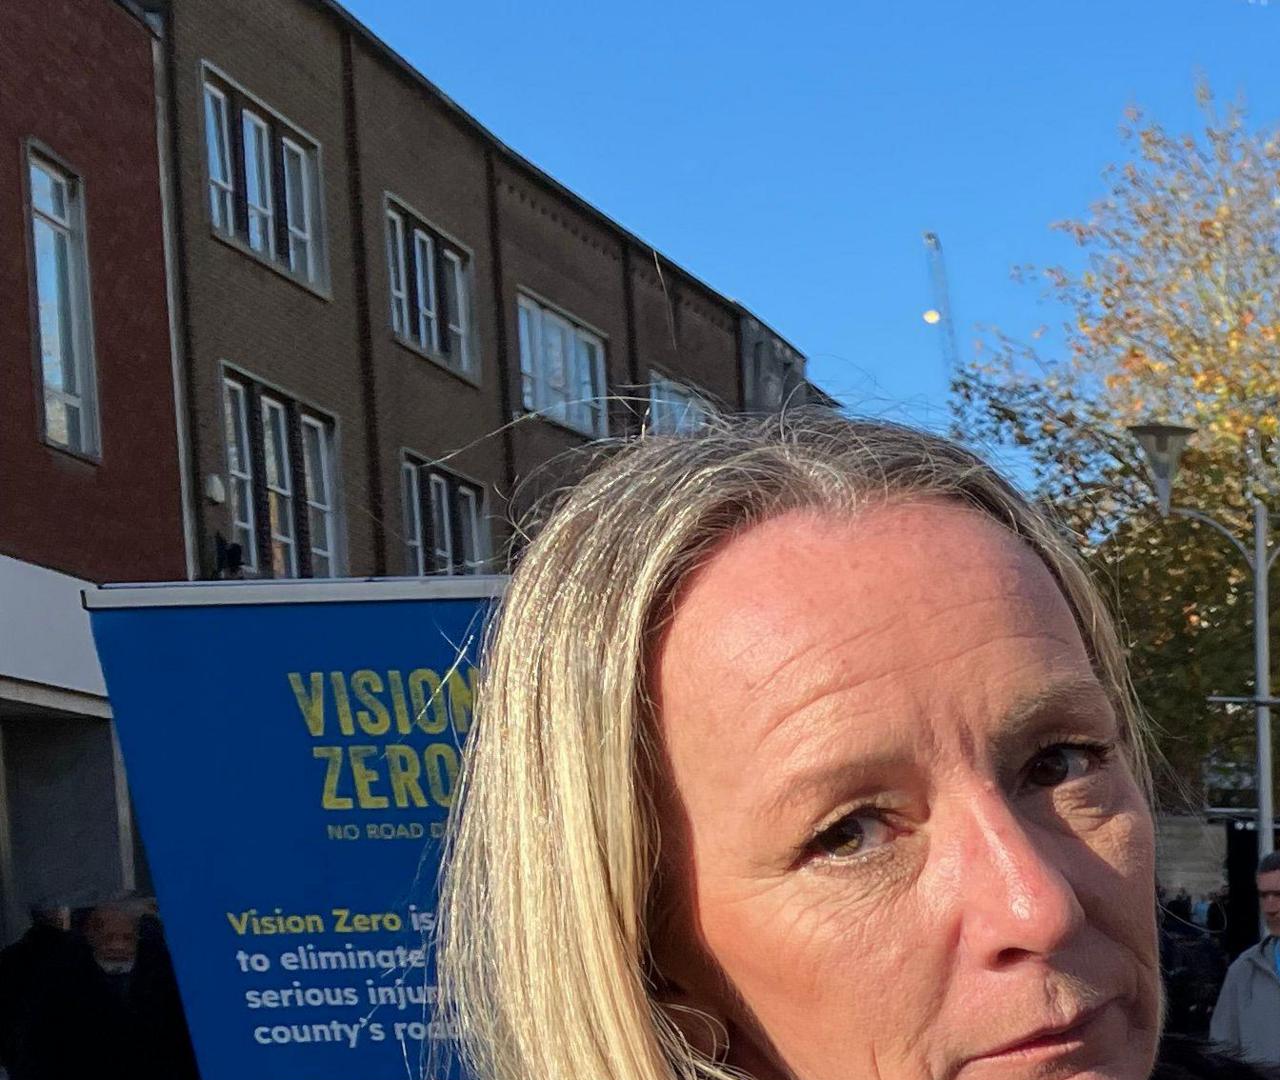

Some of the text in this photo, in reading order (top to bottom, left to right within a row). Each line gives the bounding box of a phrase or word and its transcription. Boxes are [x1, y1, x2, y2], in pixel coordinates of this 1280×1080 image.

[288, 668, 479, 736] VISION
[313, 743, 459, 810] ZERO
[327, 824, 360, 840] NO
[366, 823, 424, 840] ROAD
[227, 904, 436, 935] Vision Zero is
[236, 943, 427, 972] to eliminate
[245, 978, 441, 1010] serious injur
